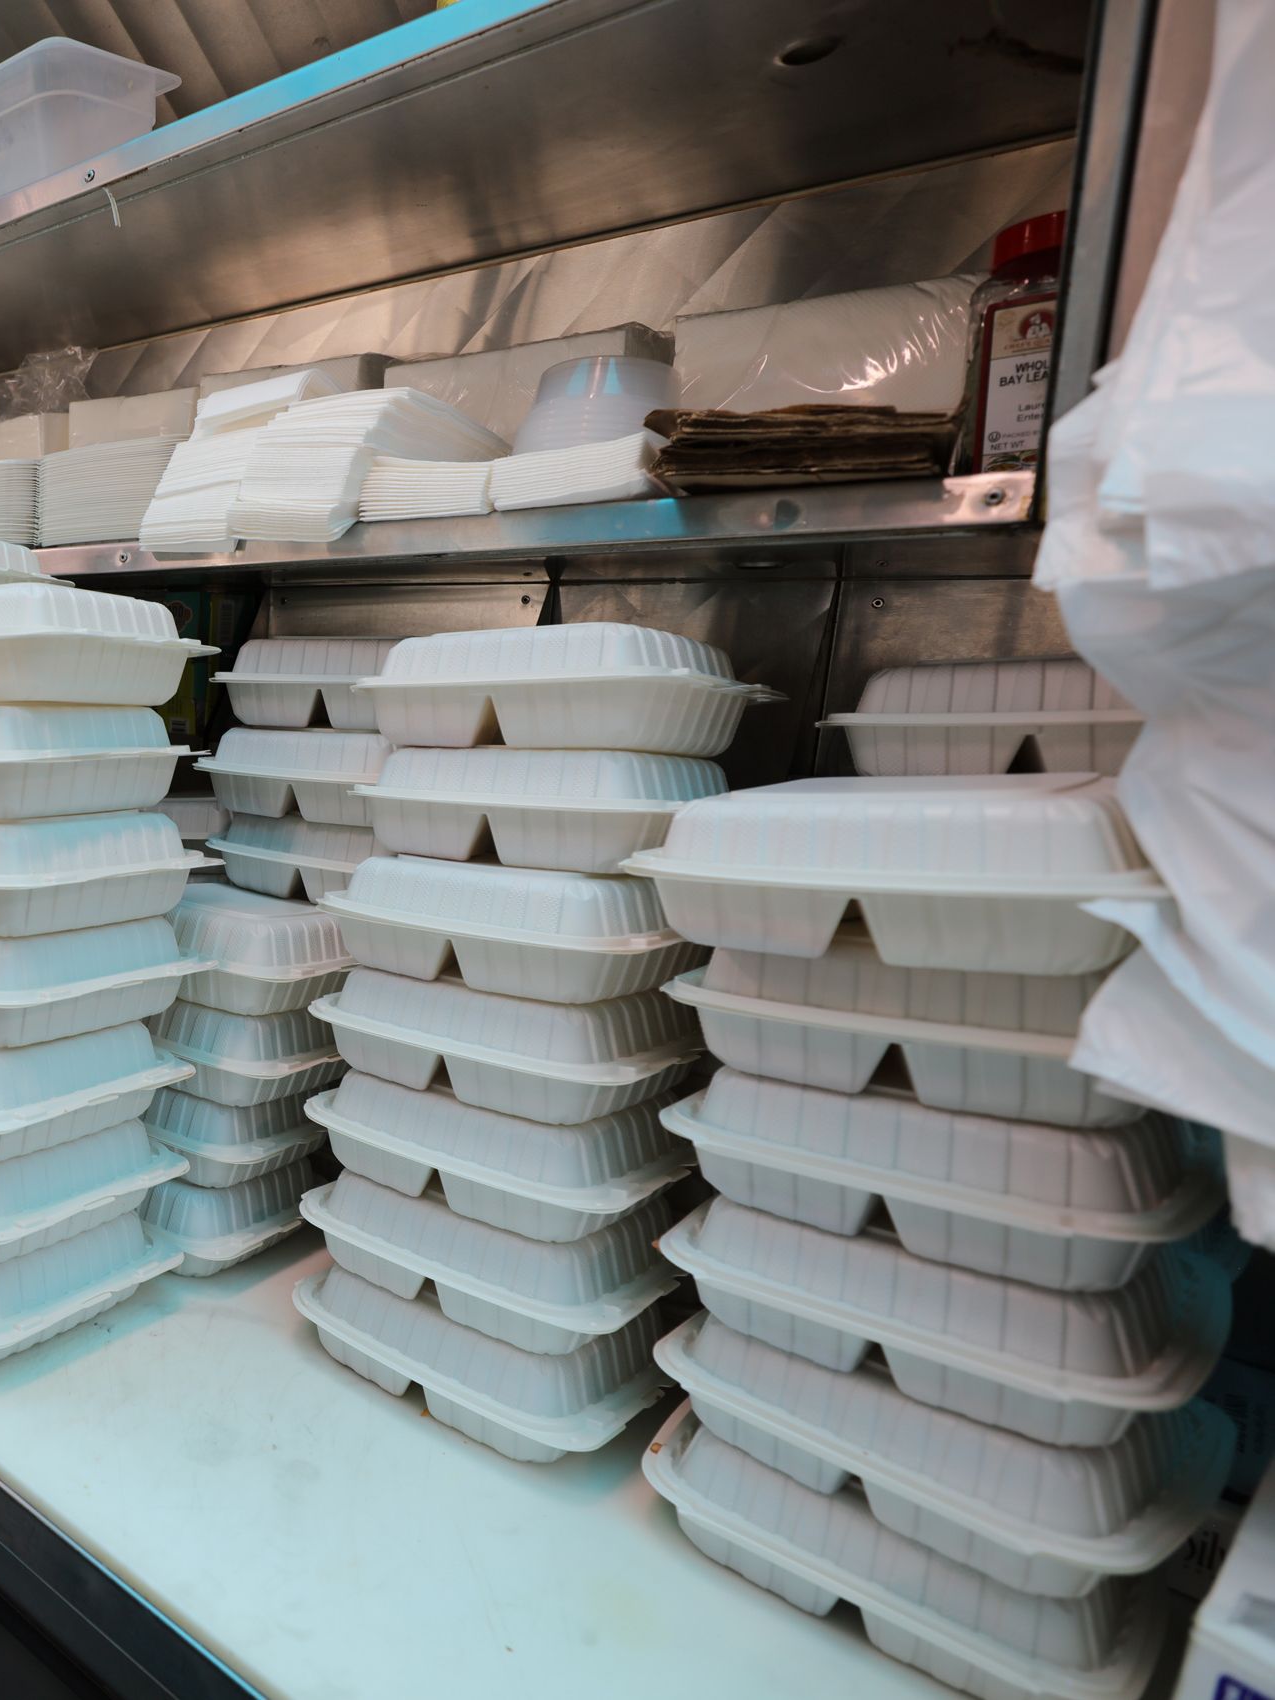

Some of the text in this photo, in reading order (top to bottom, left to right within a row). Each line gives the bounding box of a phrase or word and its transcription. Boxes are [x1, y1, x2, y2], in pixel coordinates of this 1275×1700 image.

[1015, 359, 1050, 373] WHOL
[999, 370, 1050, 387] BAY LEA
[1018, 402, 1045, 412] Laur
[990, 442, 1008, 450] NET
